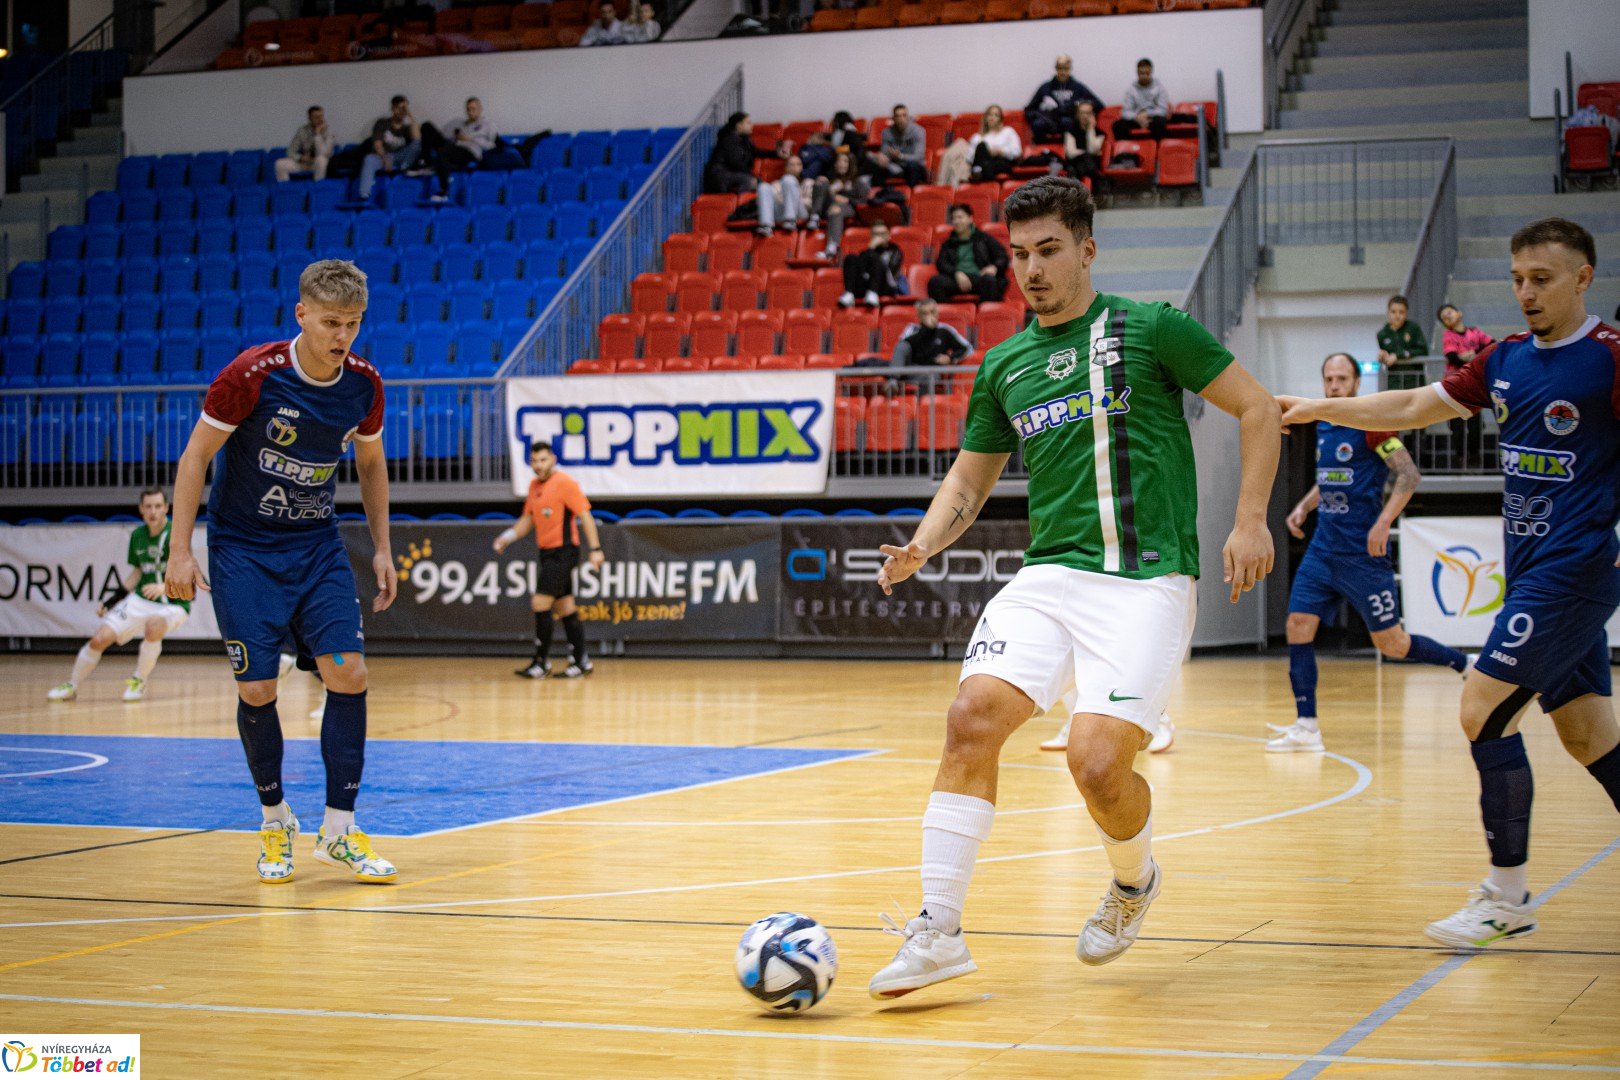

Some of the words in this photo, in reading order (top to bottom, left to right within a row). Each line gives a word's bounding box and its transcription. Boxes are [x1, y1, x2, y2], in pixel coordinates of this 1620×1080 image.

[277, 406, 300, 418] JAKO
[1010, 387, 1131, 440] TiPPMX
[1497, 446, 1572, 480] PPMIX
[258, 502, 331, 520] STUDIO
[410, 560, 502, 605] 99.4
[505, 560, 687, 599] SSHINE
[689, 559, 759, 604] FM
[576, 602, 610, 621] sak
[636, 602, 687, 621] zene!
[1368, 590, 1395, 616] 33
[1501, 612, 1534, 648] 9
[1489, 649, 1518, 667] JAKO
[344, 782, 361, 790] JA
